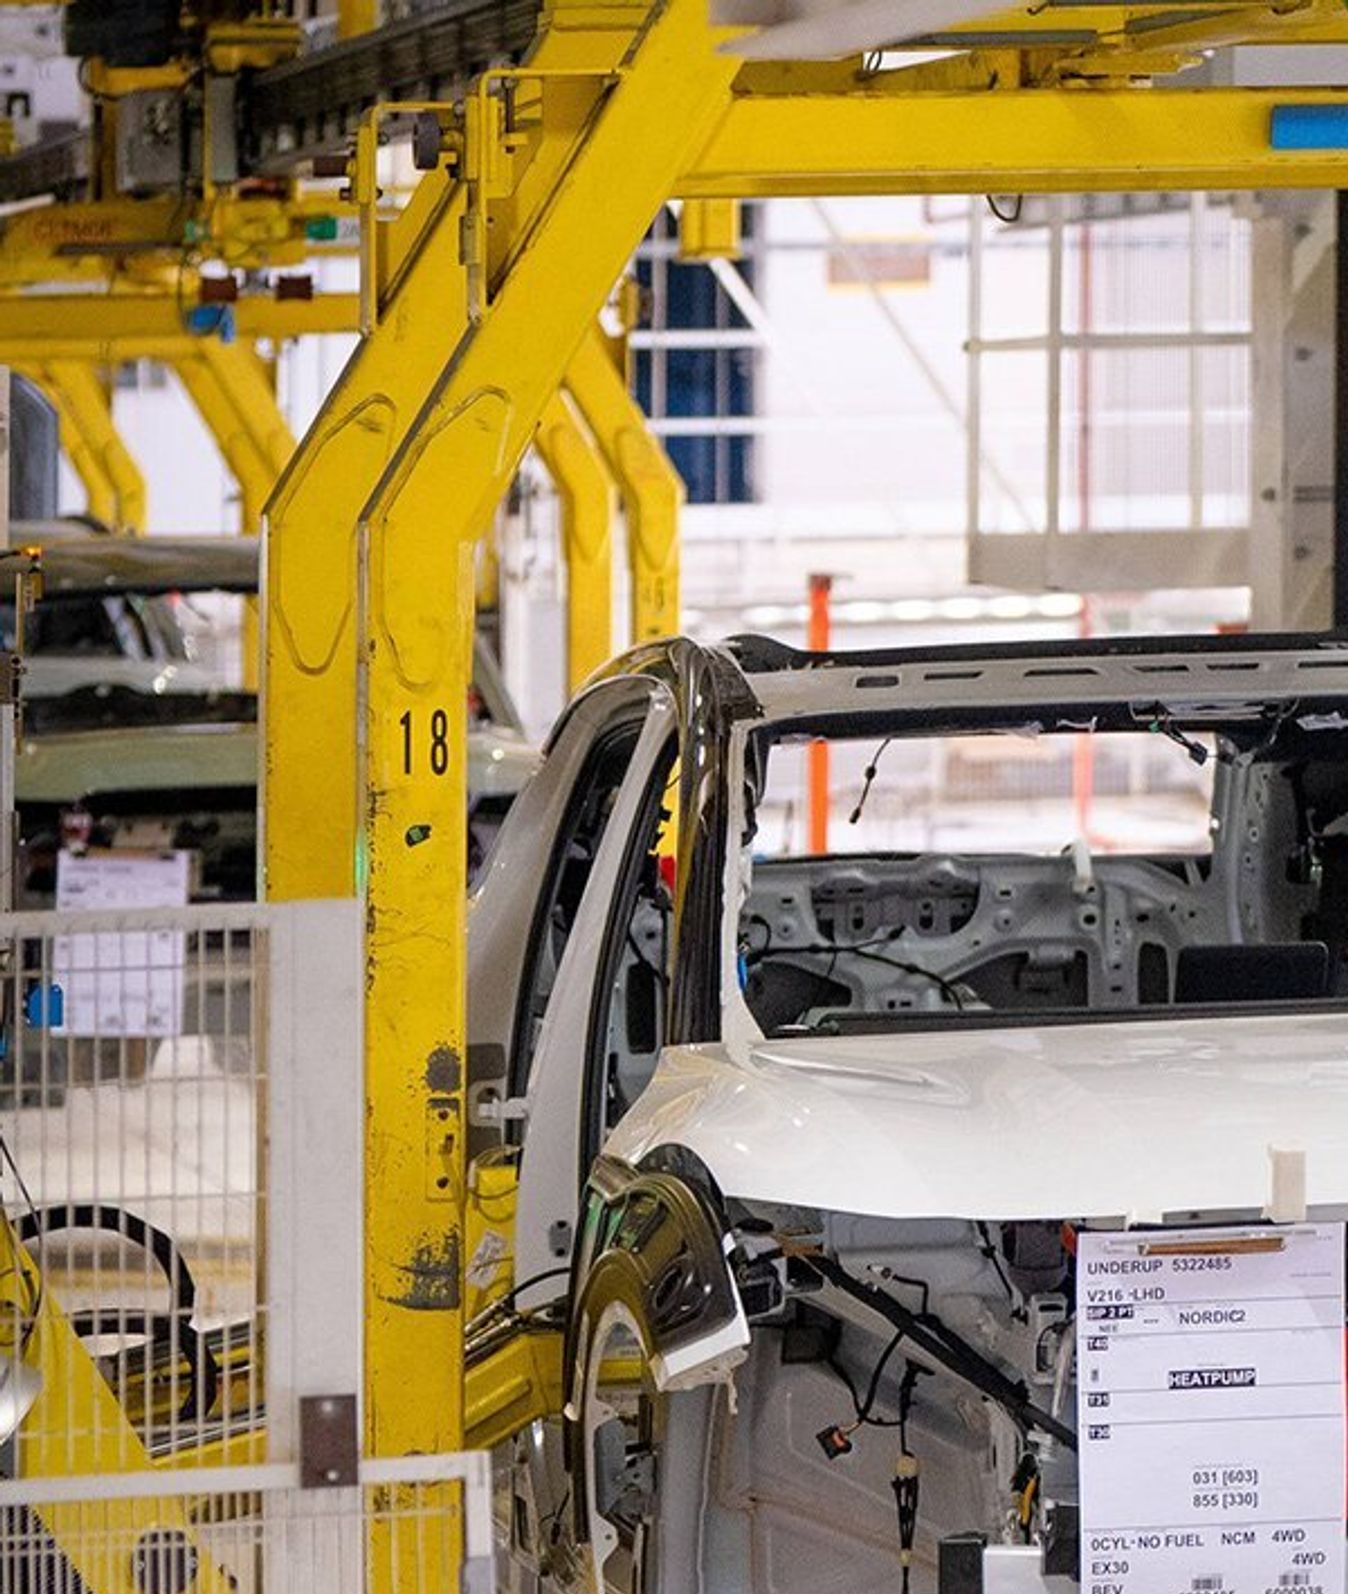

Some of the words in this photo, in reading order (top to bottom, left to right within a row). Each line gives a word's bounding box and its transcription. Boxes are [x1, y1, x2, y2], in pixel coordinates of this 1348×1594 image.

[399, 709, 448, 776] 18
[1086, 1260, 1163, 1275] UNDERUP
[1172, 1257, 1232, 1273] 5322485
[1086, 1289, 1124, 1303] V216
[1179, 1310, 1246, 1325] NORDIC2
[1168, 1369, 1256, 1389] HEATPUMP
[1192, 1471, 1217, 1485] 031
[1222, 1469, 1259, 1486] [603]
[1192, 1494, 1219, 1508] 855
[1222, 1492, 1259, 1509] [330]
[1164, 1534, 1205, 1548] FUEL
[1220, 1531, 1256, 1545] NCM
[1271, 1528, 1306, 1543] 4WD
[1091, 1561, 1129, 1576] EX30
[1291, 1551, 1327, 1565] 4WD
